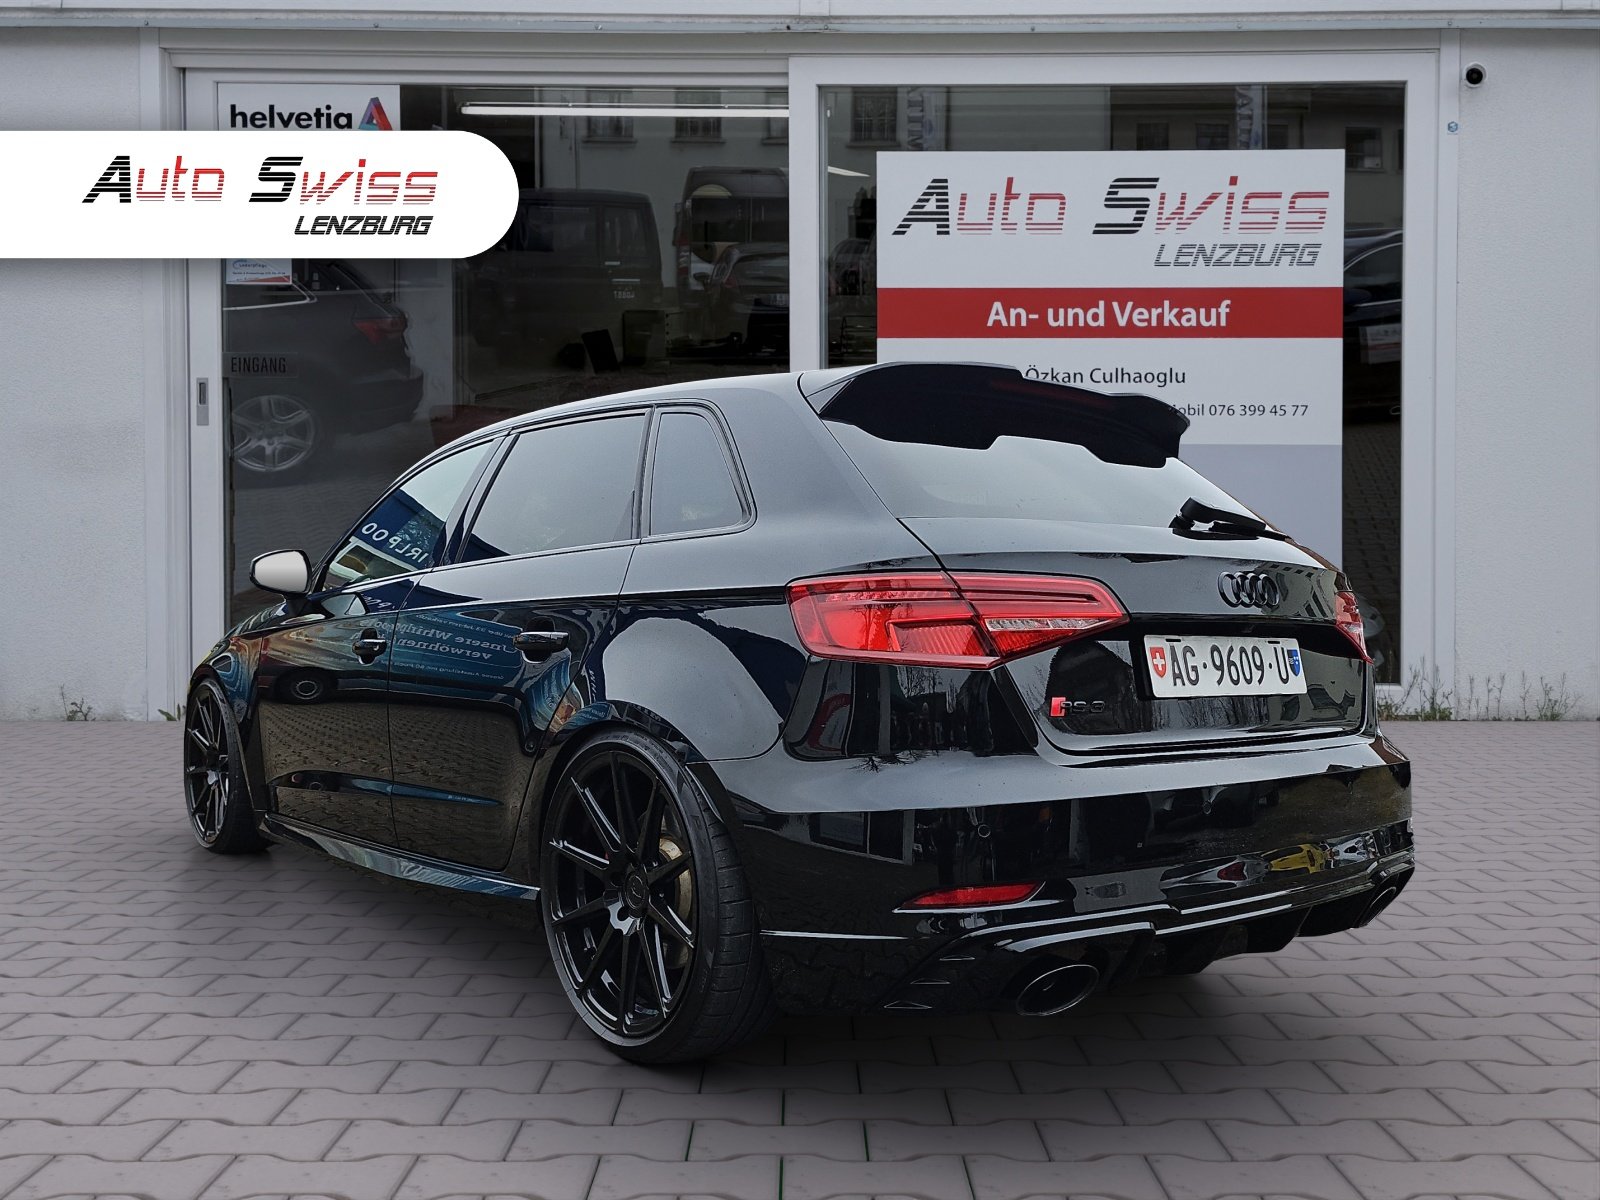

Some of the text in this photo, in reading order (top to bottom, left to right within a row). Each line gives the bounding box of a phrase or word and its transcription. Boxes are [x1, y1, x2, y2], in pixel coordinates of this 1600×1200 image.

[230, 104, 353, 130] helvetia
[892, 176, 1330, 236] Auto Swiss
[1154, 243, 1322, 267] LENZBURG
[986, 300, 1231, 328] An- und Verkauf
[231, 357, 287, 373] EINGANG
[1025, 364, 1186, 387] Özkan Culhaoglu
[1172, 403, 1309, 417] obil 076 399 45 77
